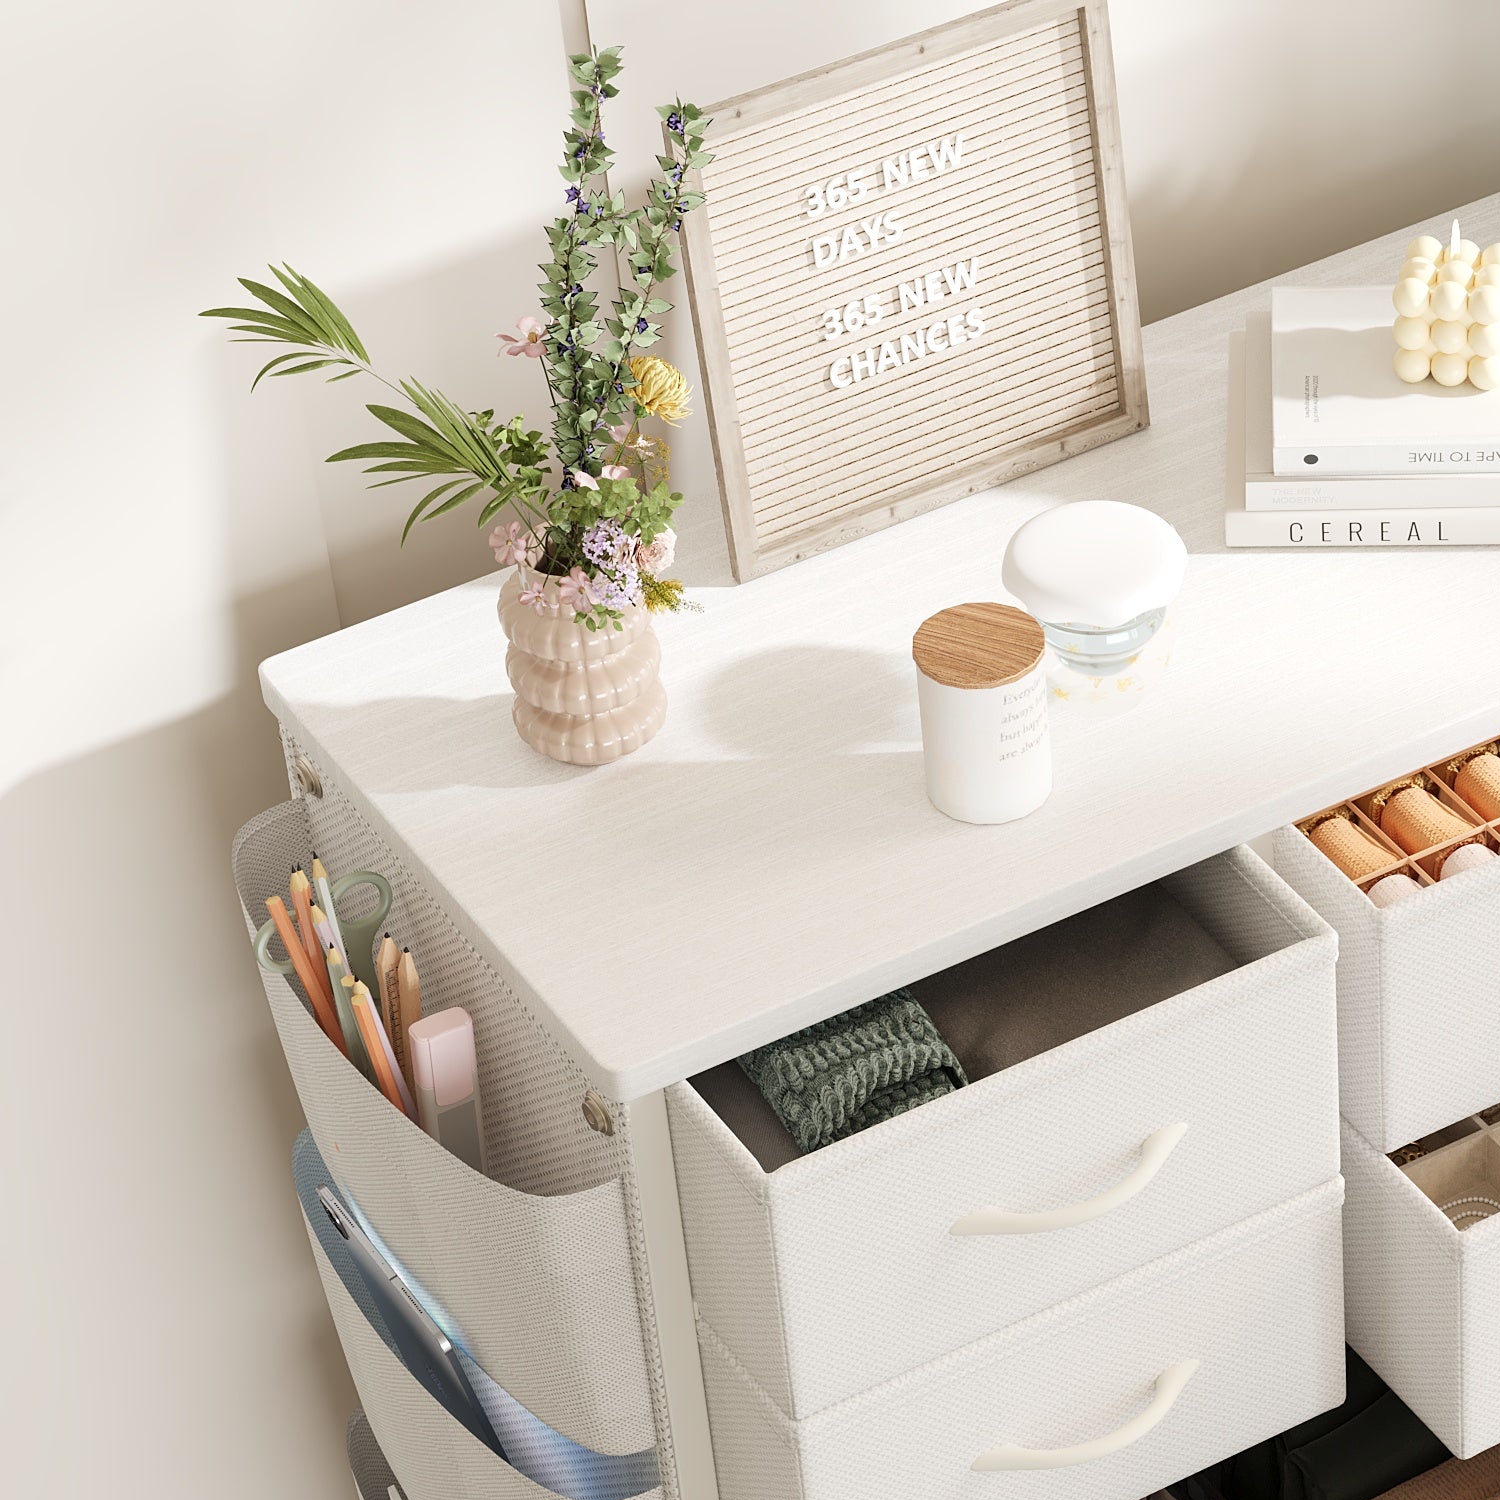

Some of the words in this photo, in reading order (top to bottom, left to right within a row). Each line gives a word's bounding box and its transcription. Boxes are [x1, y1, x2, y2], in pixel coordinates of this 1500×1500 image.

[804, 170, 868, 218] 365
[880, 133, 965, 190] NEW
[811, 210, 904, 269] DAYS
[822, 292, 884, 341] 365
[897, 256, 980, 314] NEW
[828, 307, 987, 390] CHANCES
[1408, 451, 1445, 463] TIME
[1449, 451, 1472, 462] TO
[1289, 521, 1449, 543] CEREAL
